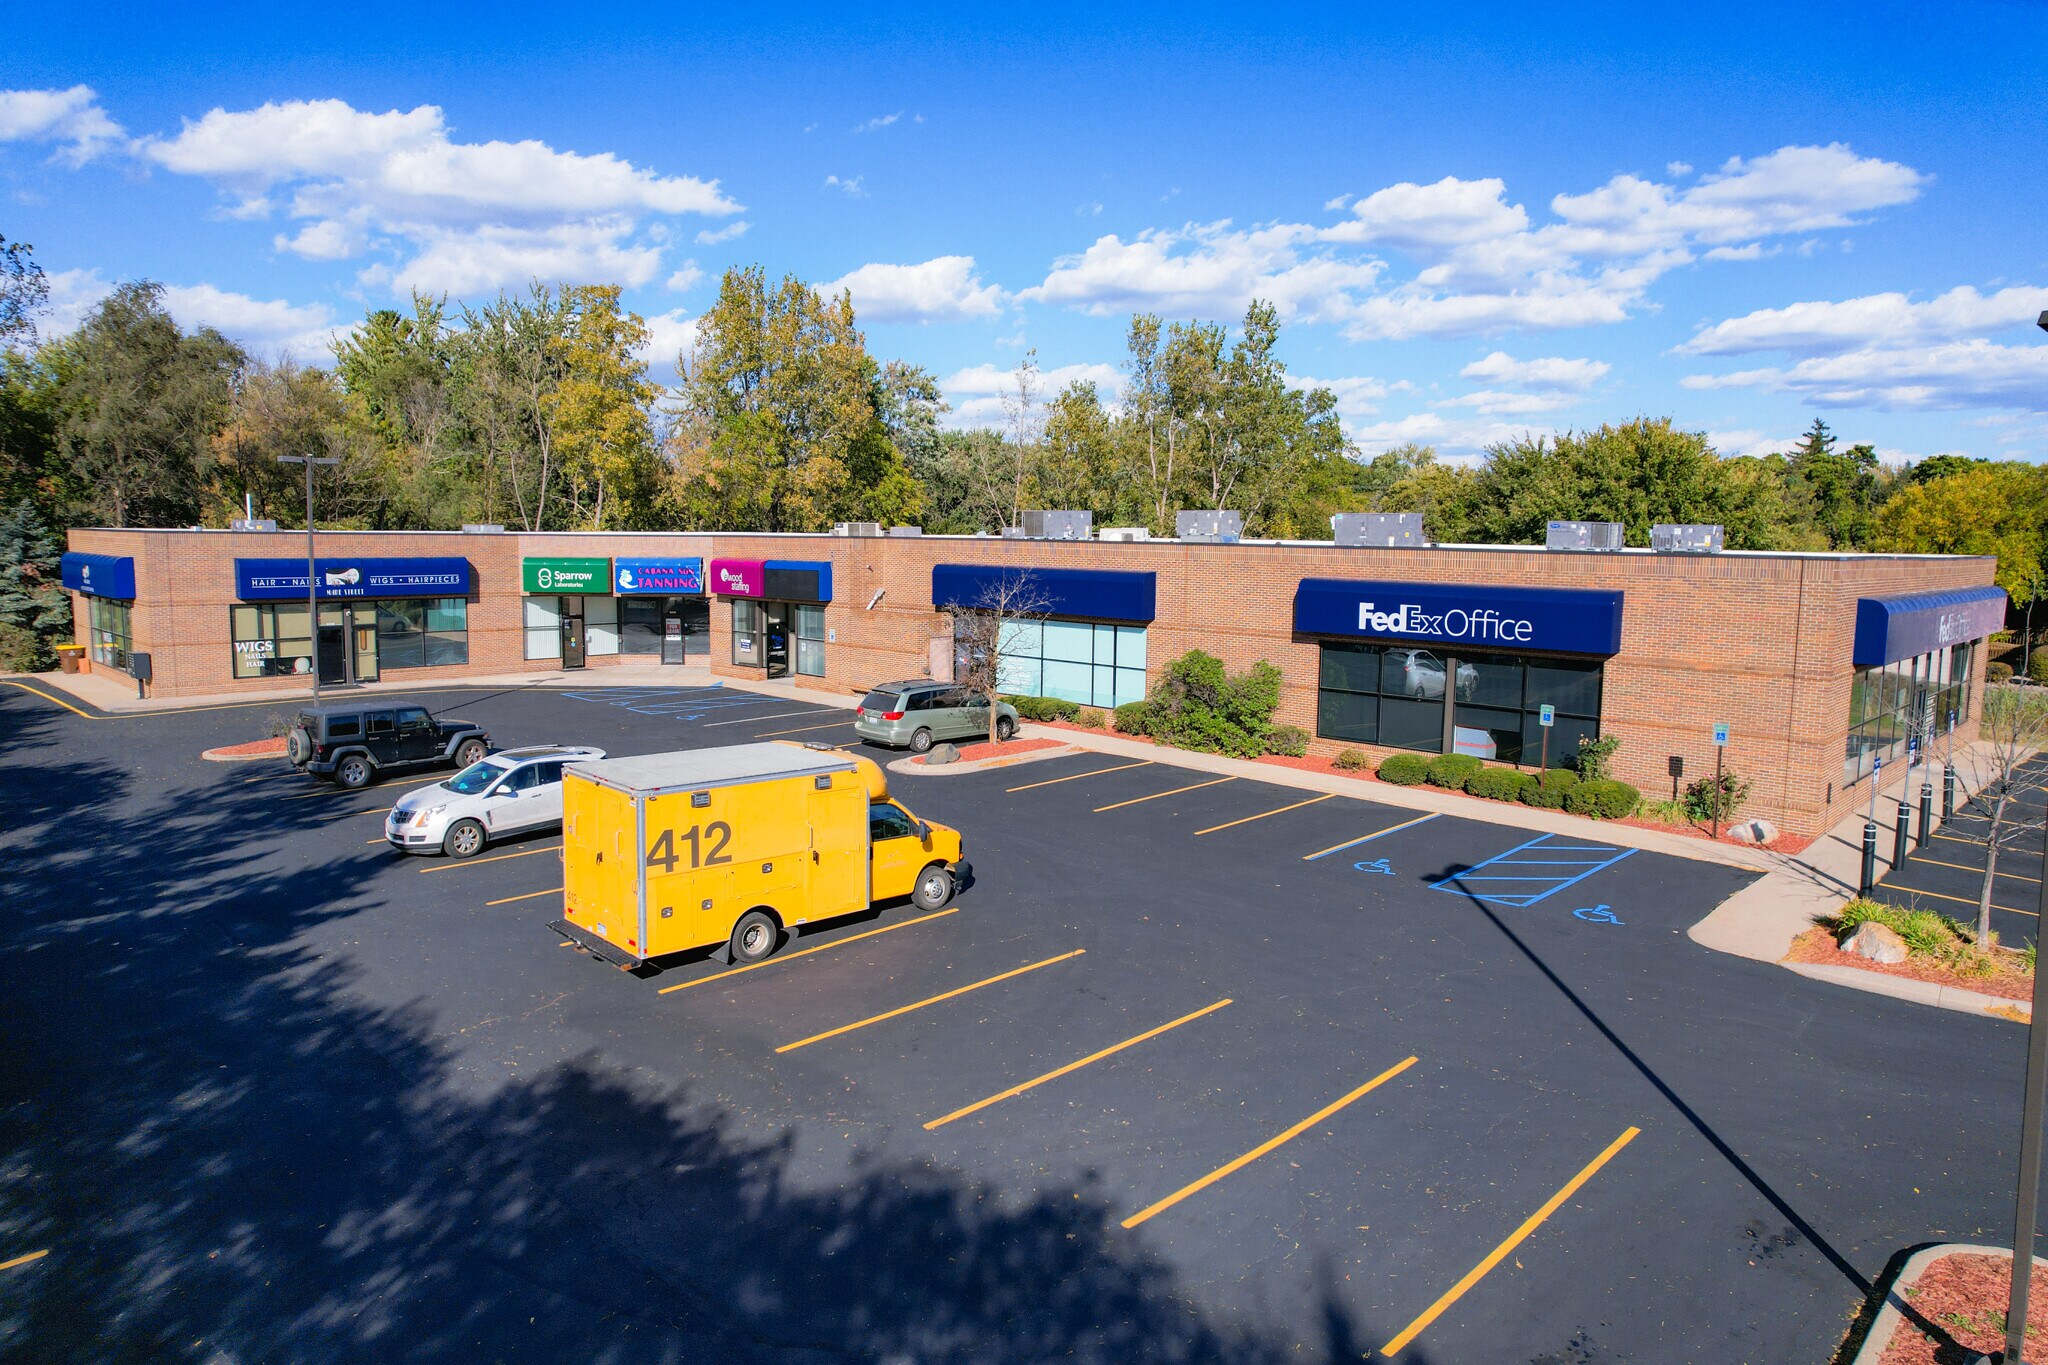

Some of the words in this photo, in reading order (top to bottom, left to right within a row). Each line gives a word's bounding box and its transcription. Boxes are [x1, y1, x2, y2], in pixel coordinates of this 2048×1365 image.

[554, 571, 592, 582] Sparrow
[637, 578, 698, 588] TANNING
[1358, 602, 1443, 635] FedEx
[1444, 609, 1533, 641] Office
[234, 641, 273, 653] WIGS
[646, 821, 732, 873] 412
